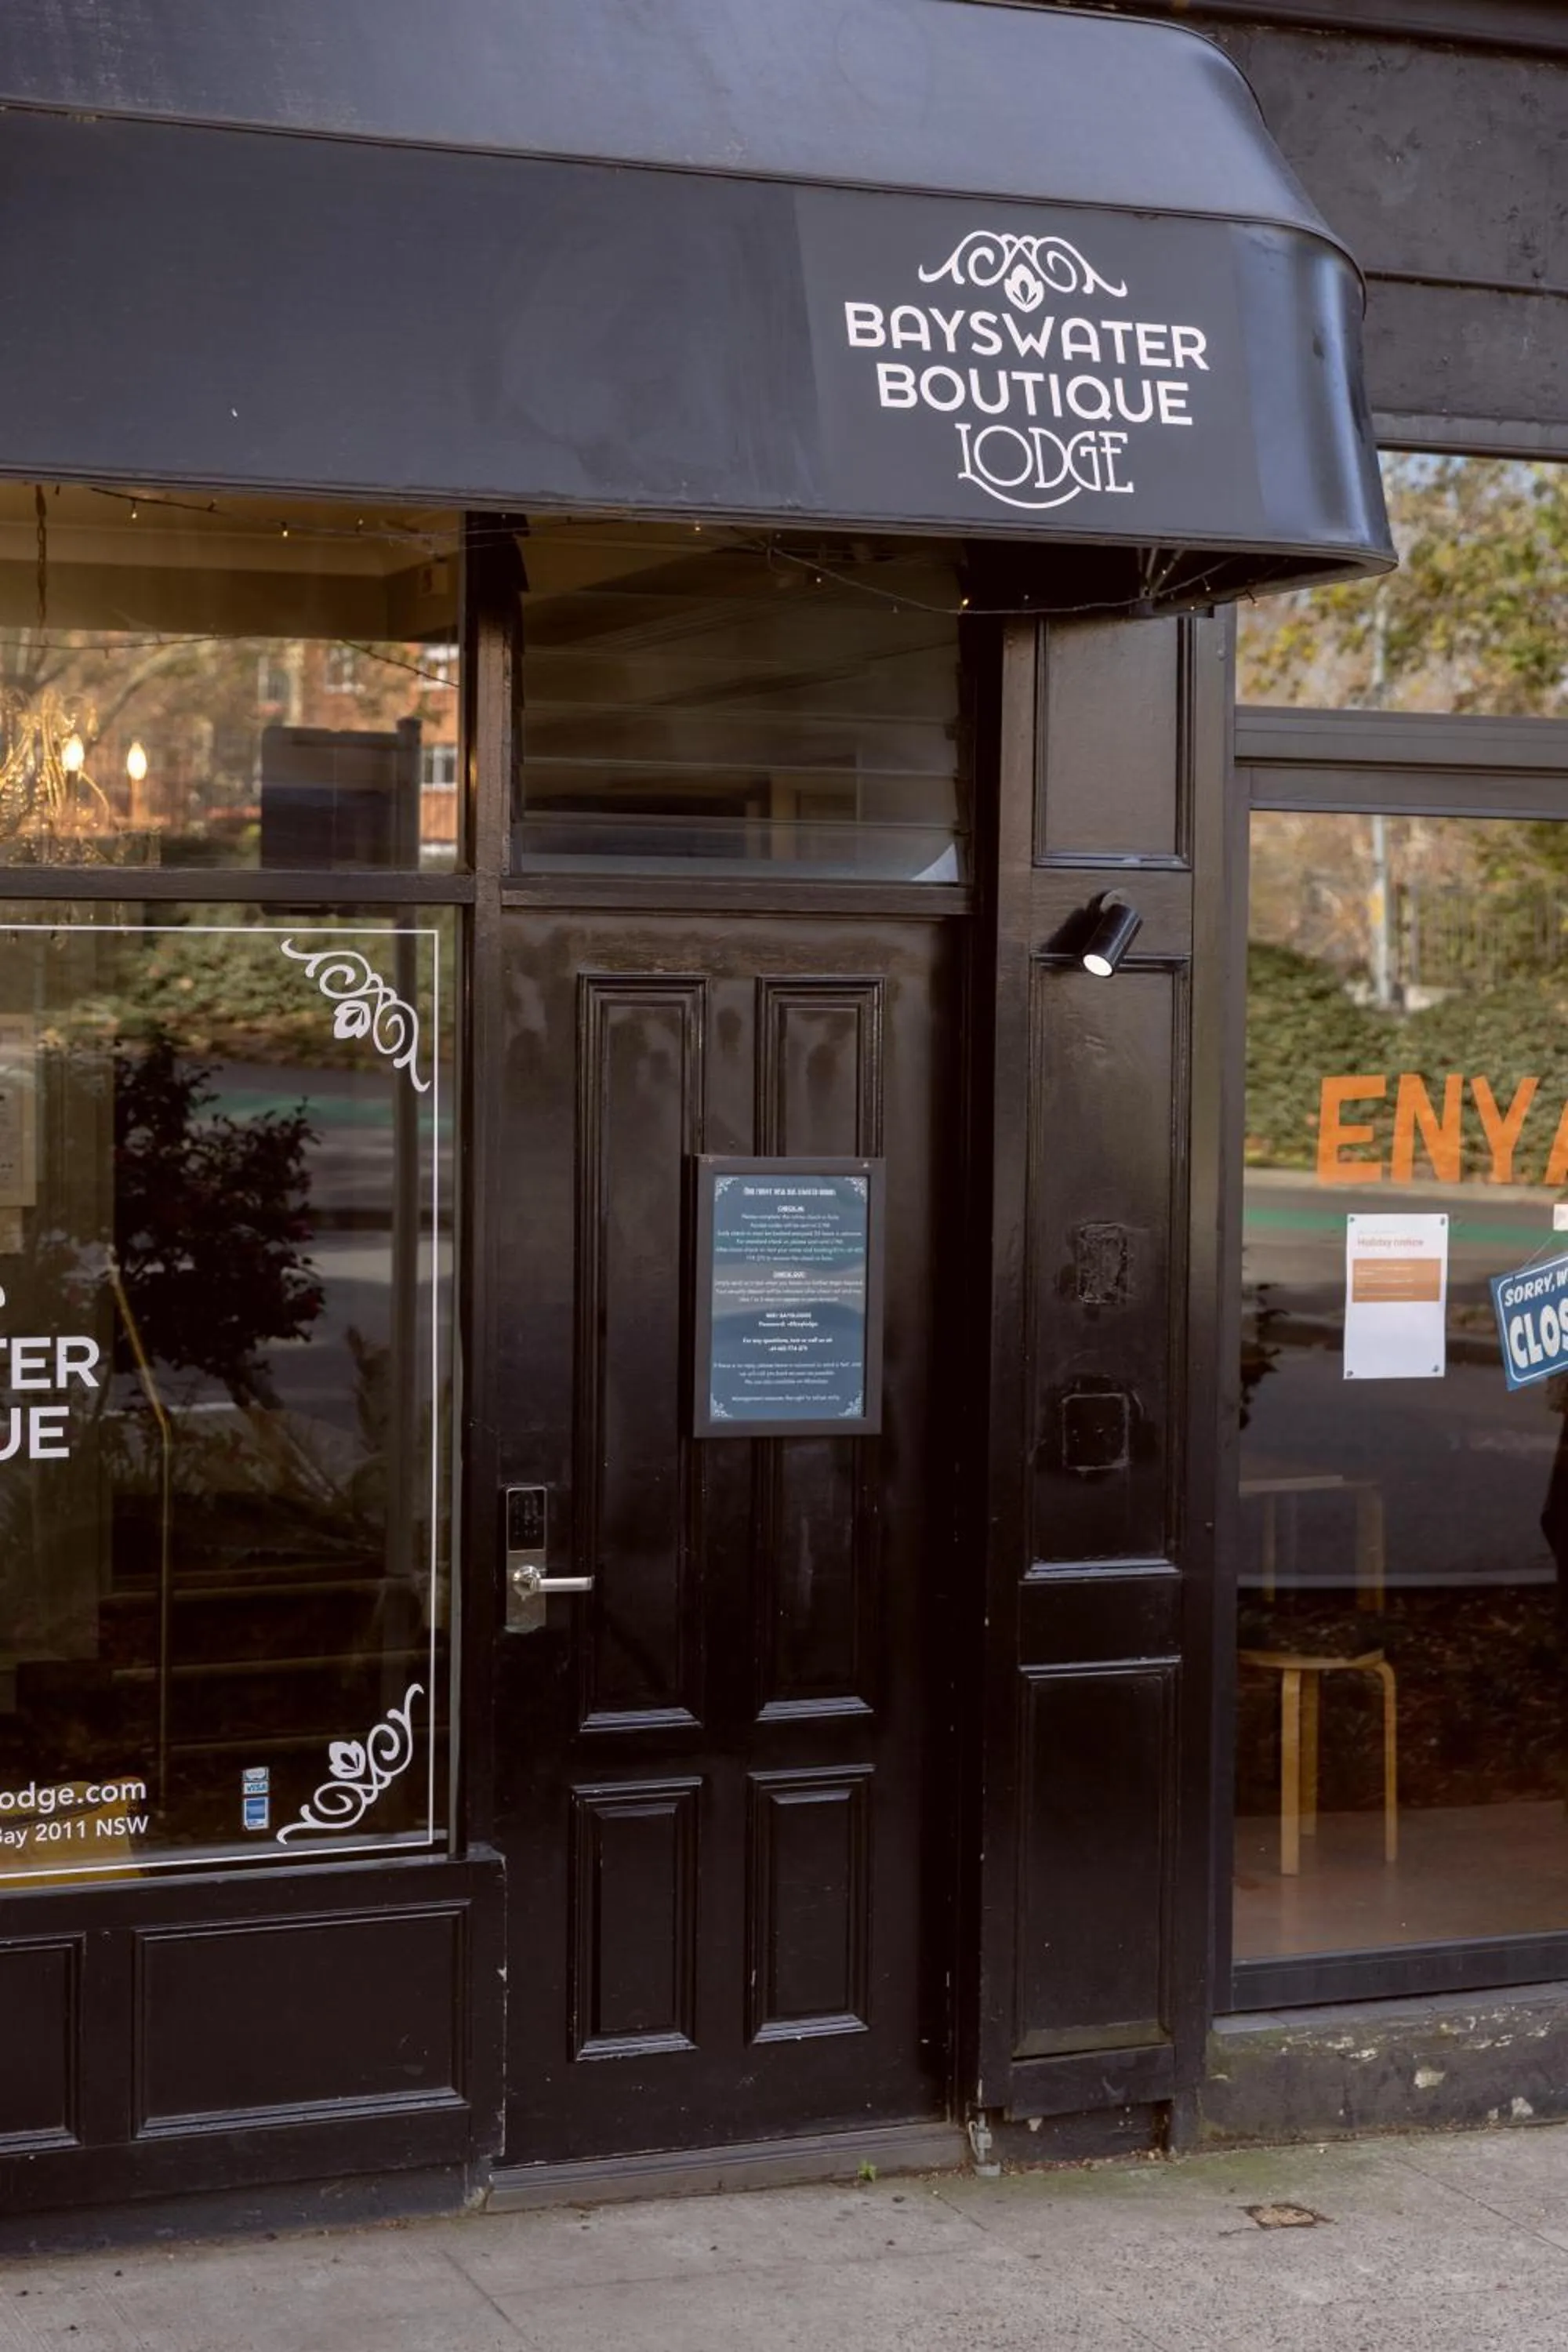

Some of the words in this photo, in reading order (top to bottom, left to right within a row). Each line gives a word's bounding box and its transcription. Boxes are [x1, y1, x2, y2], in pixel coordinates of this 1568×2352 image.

[844, 302, 1210, 371] BAYSWATER
[876, 362, 1193, 426] BOUTIQUE
[954, 422, 1134, 510] LODGE
[0, 1335, 100, 1390] ER
[0, 1828, 28, 1849] ay
[35, 1820, 86, 1842] 2011
[96, 1815, 150, 1838] NSW
